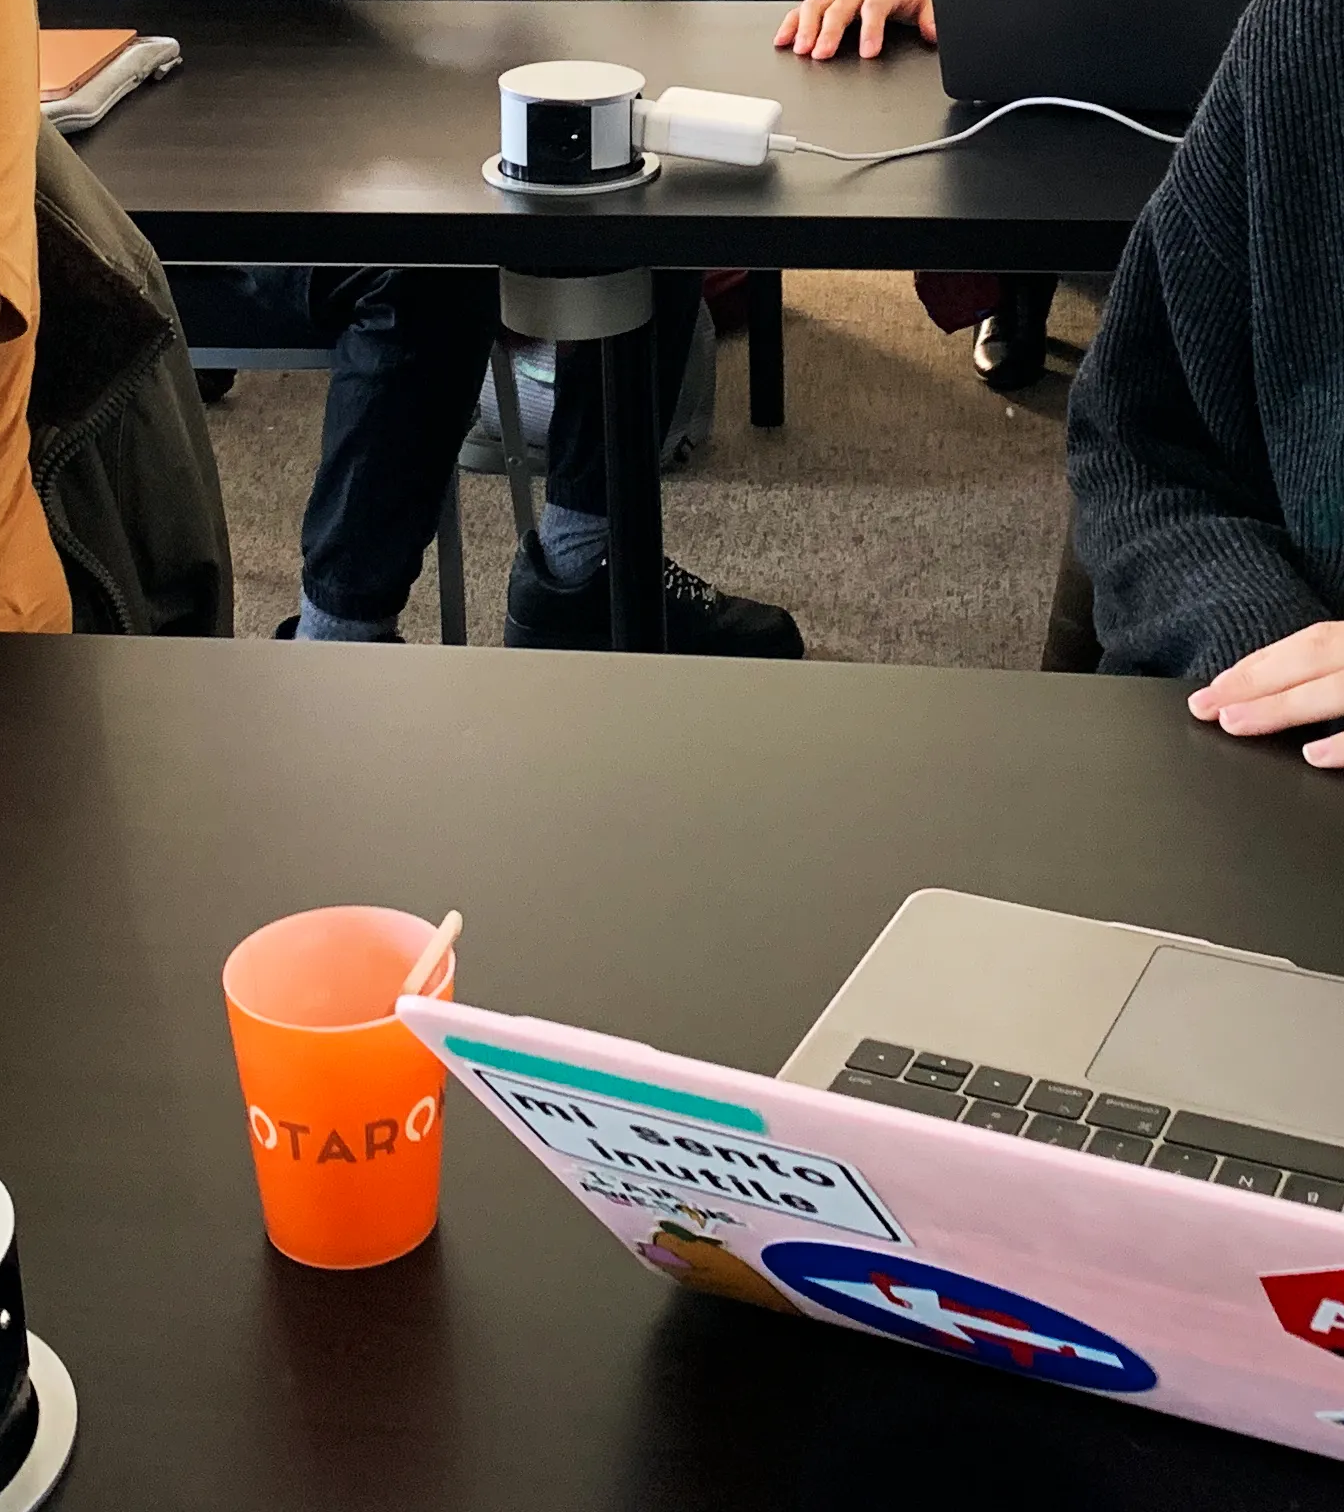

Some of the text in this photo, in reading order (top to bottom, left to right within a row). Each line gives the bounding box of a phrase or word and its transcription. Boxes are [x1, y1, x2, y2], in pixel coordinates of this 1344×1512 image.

[510, 1090, 837, 1189] mi sento
[588, 1137, 820, 1215] inutile
[1238, 1173, 1253, 1188] N
